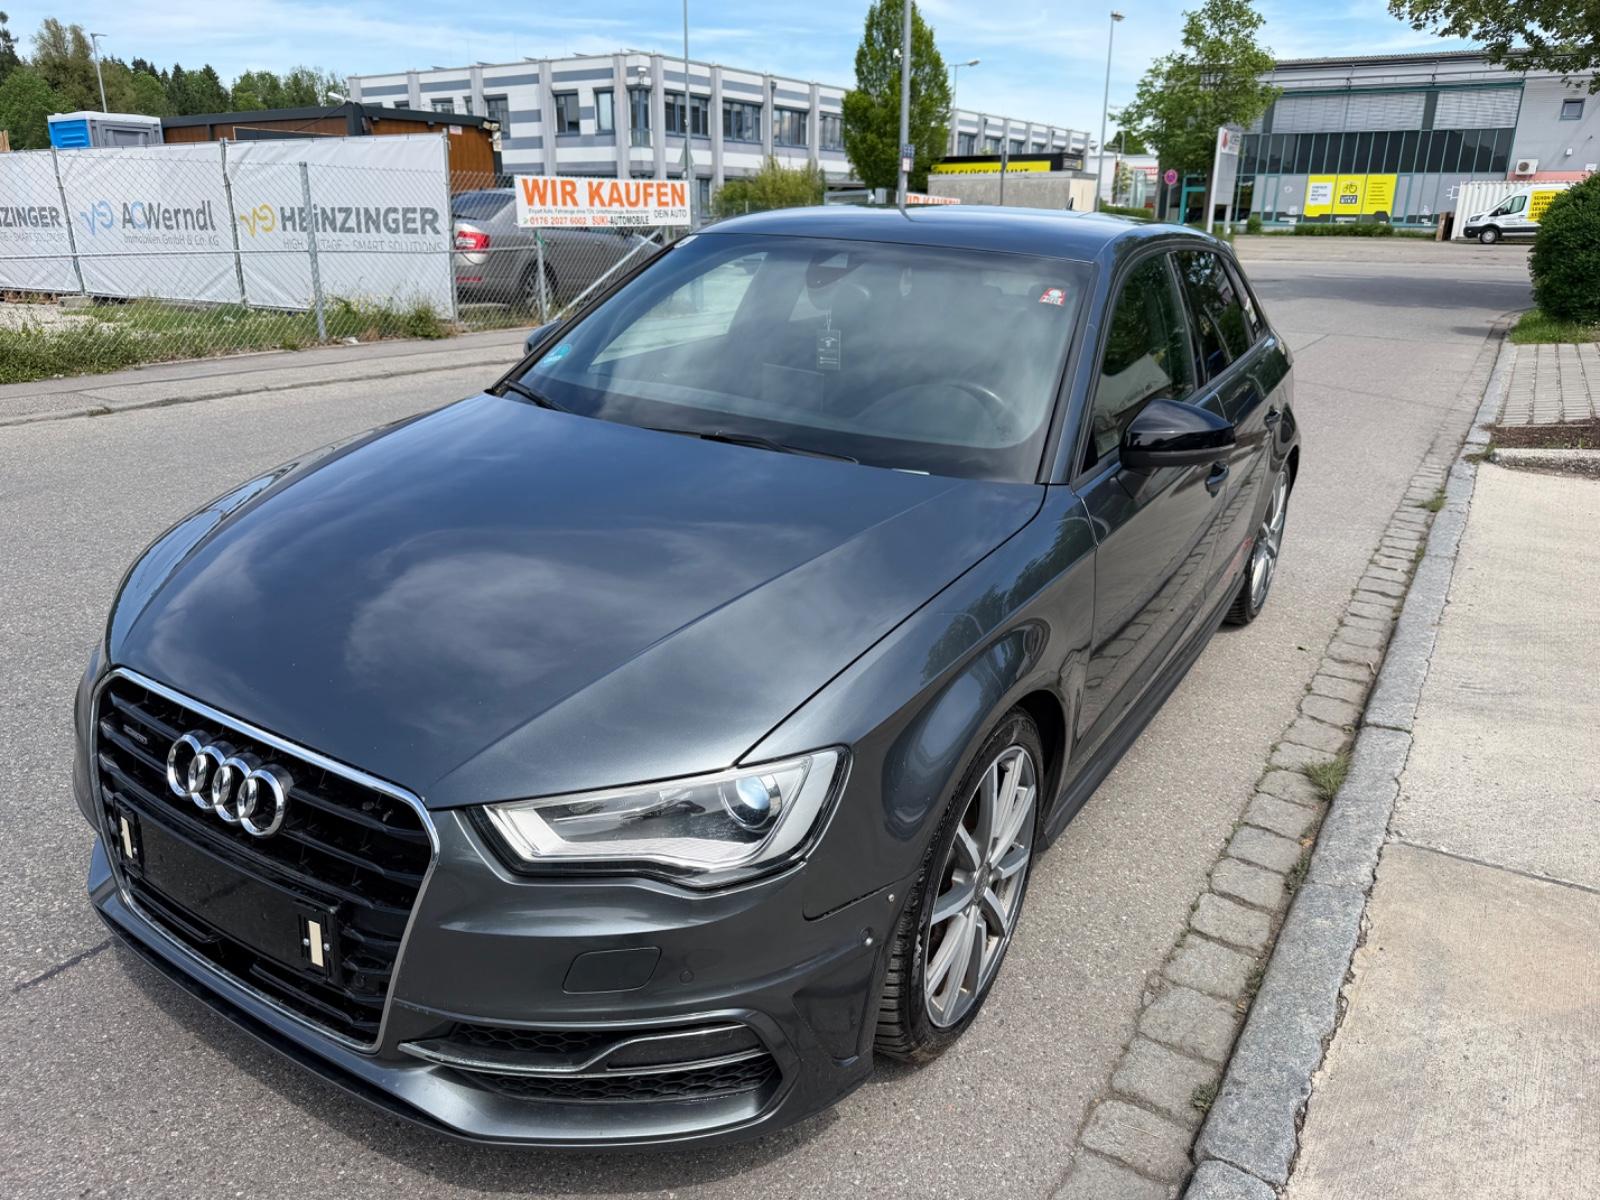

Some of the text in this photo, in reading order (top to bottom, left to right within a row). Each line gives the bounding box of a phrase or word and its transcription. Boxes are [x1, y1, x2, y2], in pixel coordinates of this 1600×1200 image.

[522, 178, 686, 208] WIR KAUFEN
[0, 206, 62, 228] ZINGER
[654, 208, 669, 218] DEIN
[671, 209, 687, 218] AUTO
